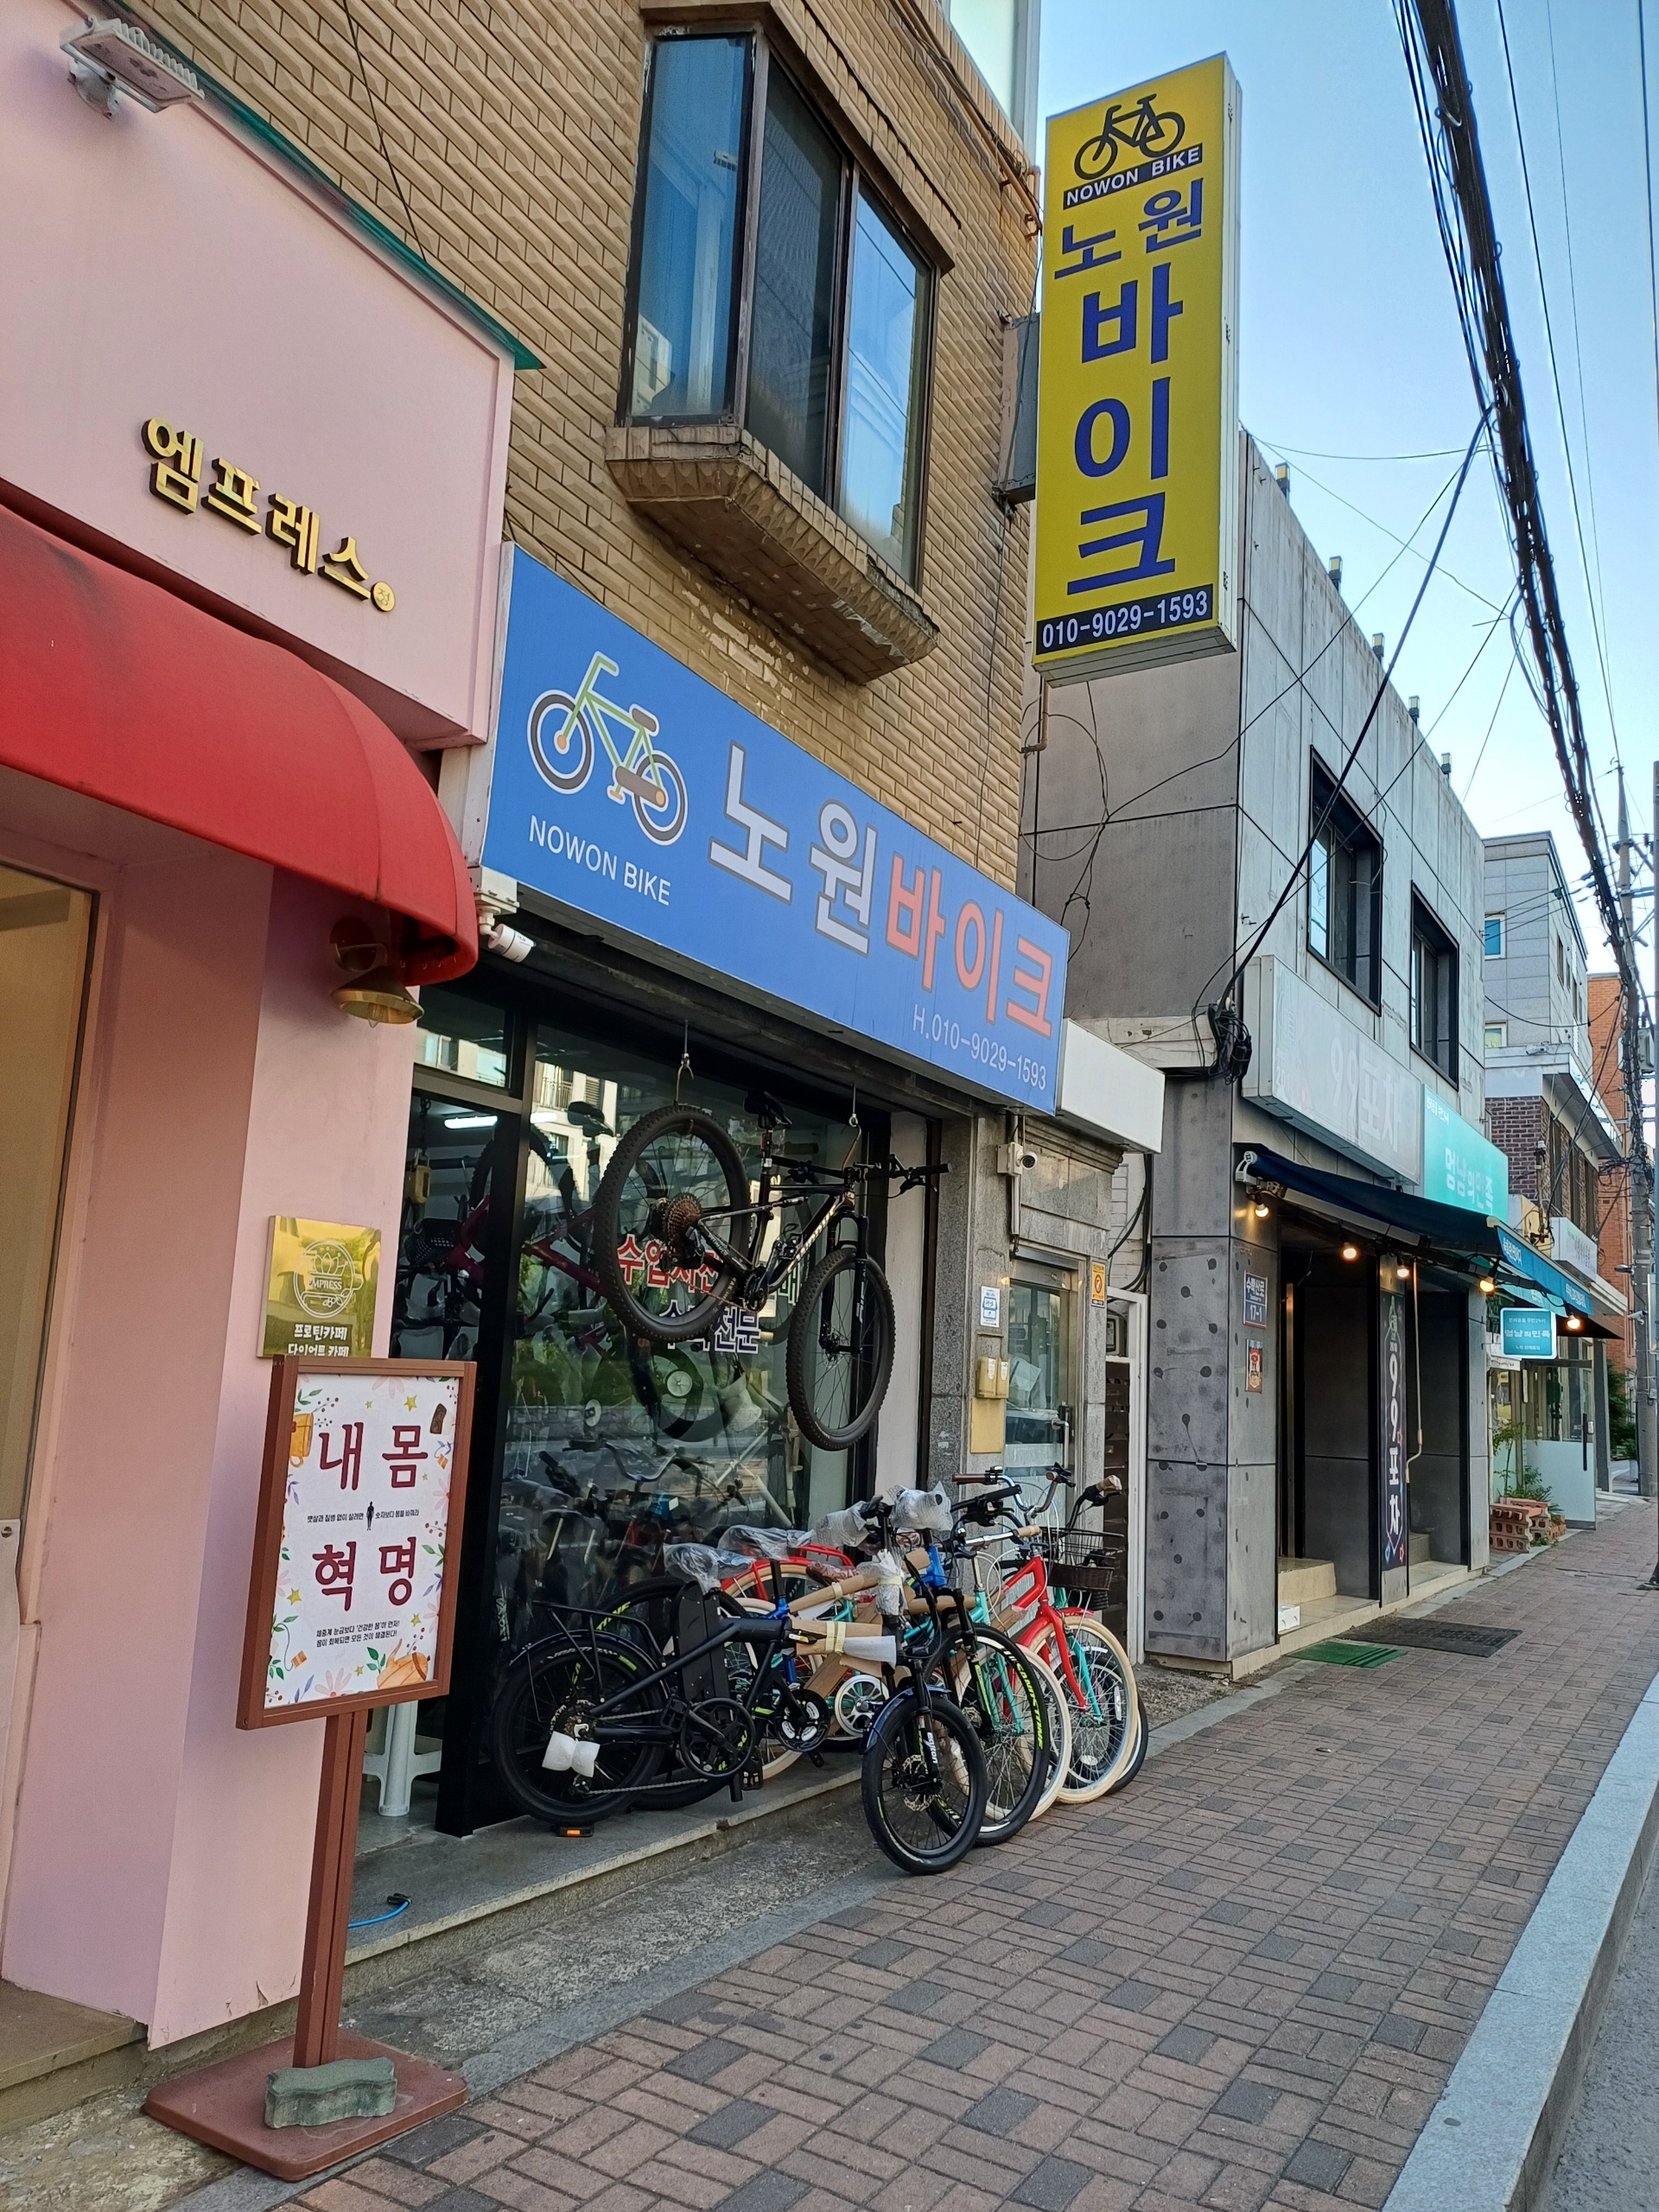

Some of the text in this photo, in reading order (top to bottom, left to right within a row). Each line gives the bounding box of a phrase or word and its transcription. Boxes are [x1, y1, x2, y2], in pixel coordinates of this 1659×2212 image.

[1065, 145, 1200, 208] NOWON BIKE
[1053, 177, 1204, 279] 노원
[1067, 262, 1185, 595] 바이크
[142, 416, 372, 601] 엠프레스
[1041, 591, 1209, 649] 010-9029-1593
[529, 814, 671, 906] NOWON BIKE
[912, 1004, 1047, 1091] H.010-9029-1593
[308, 1278, 342, 1290] EMPRESS
[1249, 1304, 1262, 1322] 17-1
[289, 1344, 350, 1357] 다이어트 카페
[294, 1324, 347, 1340] 프로틴카페
[337, 1513, 347, 1522] 없이
[363, 1633, 373, 1642] 것이
